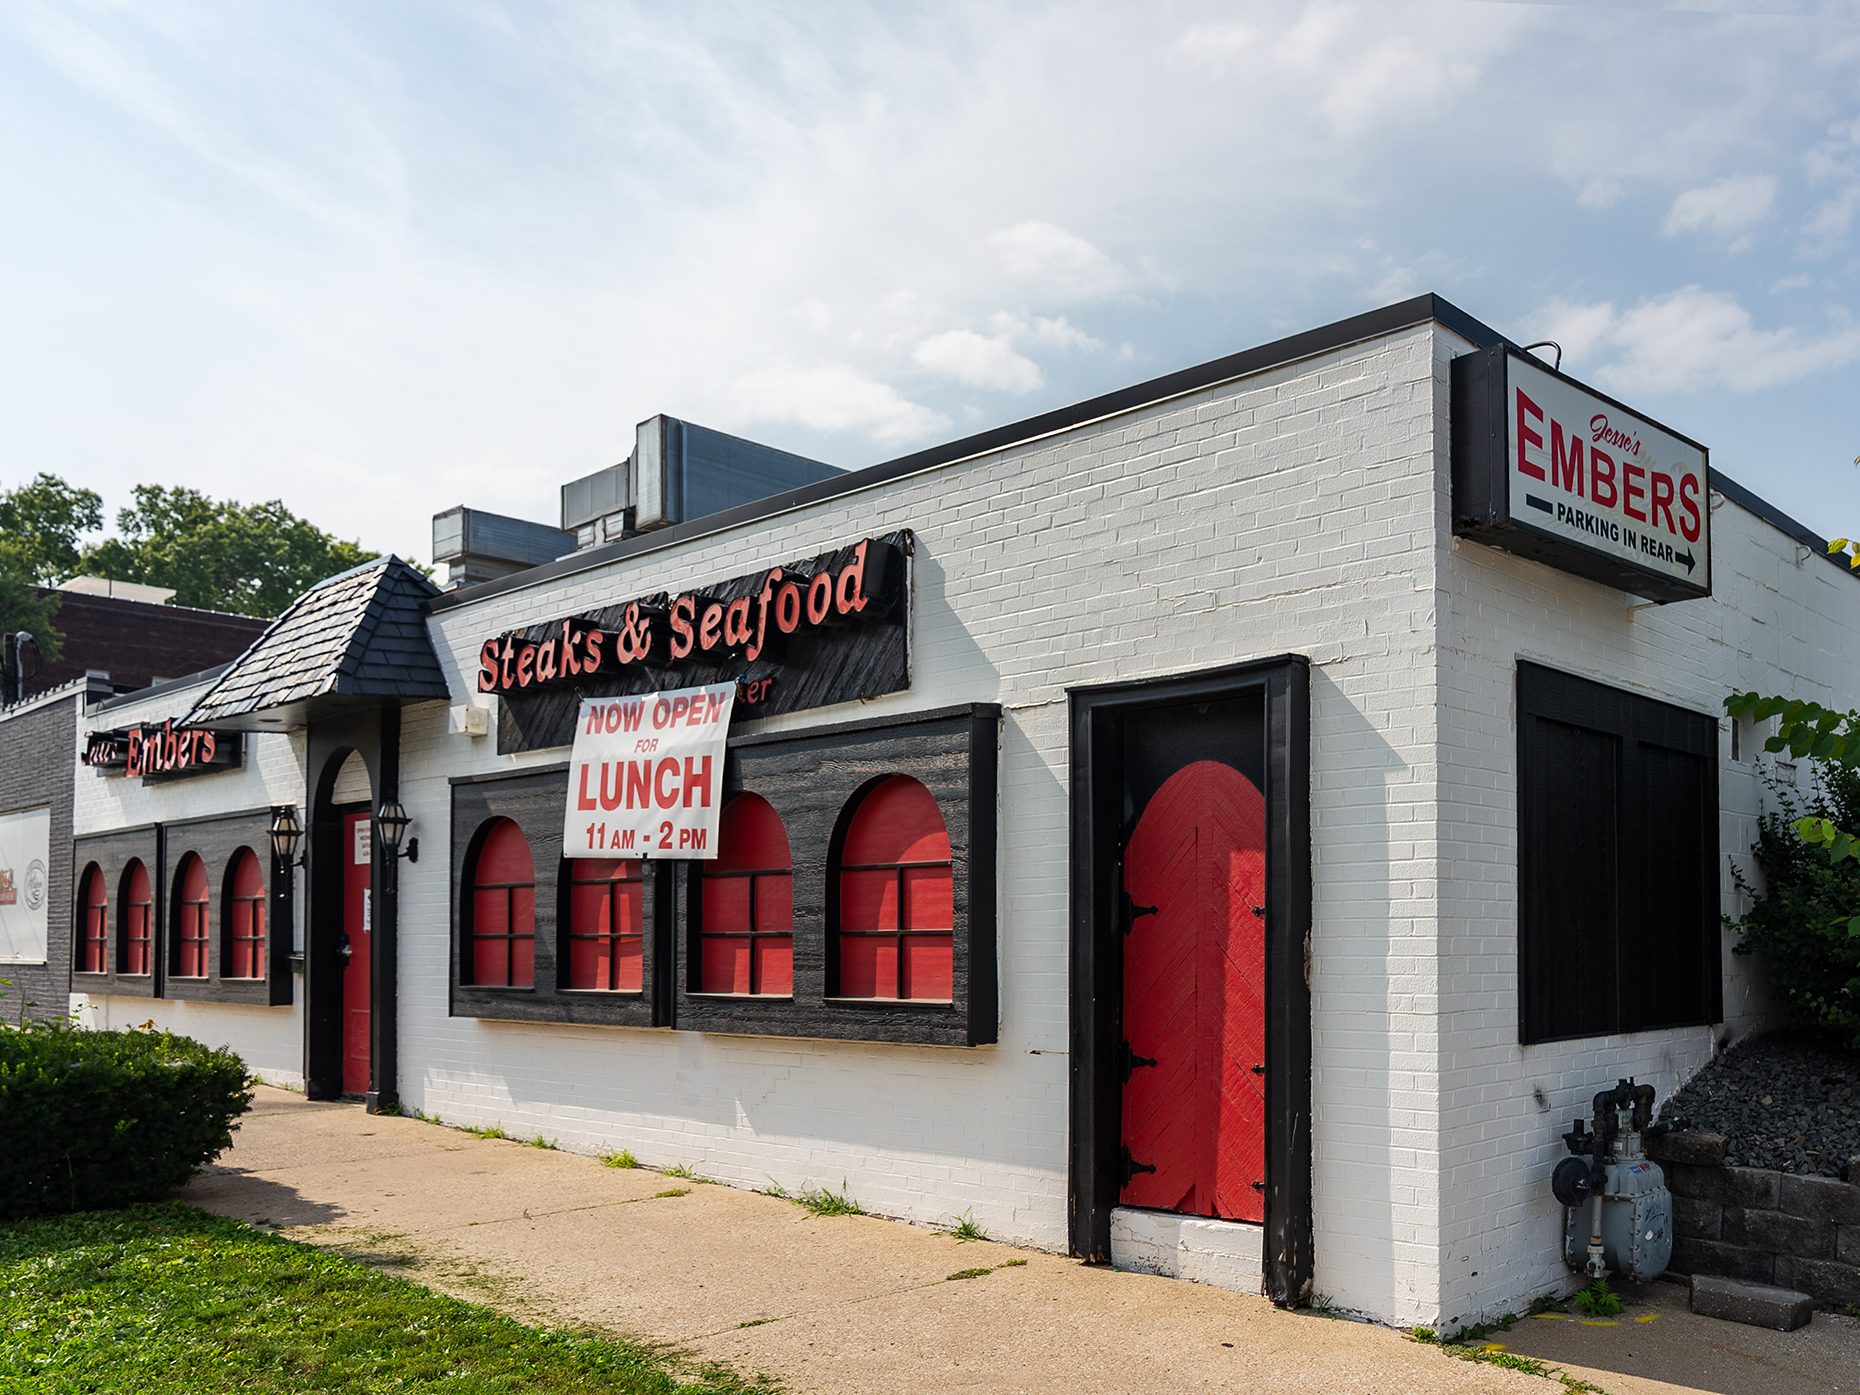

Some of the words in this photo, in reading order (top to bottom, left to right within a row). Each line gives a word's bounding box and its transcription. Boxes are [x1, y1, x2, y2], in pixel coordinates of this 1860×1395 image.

[1589, 413, 1641, 457] Jesse's
[1516, 386, 1701, 543] EMBERS
[1557, 502, 1619, 542] PARKING
[1623, 527, 1637, 550] IN
[1641, 539, 1674, 563] REAR
[478, 619, 604, 692] Steaks
[616, 602, 652, 664] &
[669, 539, 869, 662] Seafood
[586, 700, 646, 735] NOW
[652, 692, 726, 730] OPEN
[124, 719, 216, 778] Embers
[634, 738, 659, 753] FOR
[577, 755, 713, 811] LUNCH
[586, 822, 606, 849] 11
[610, 829, 636, 849] AM
[658, 821, 674, 849] 2
[679, 828, 707, 849] PM
